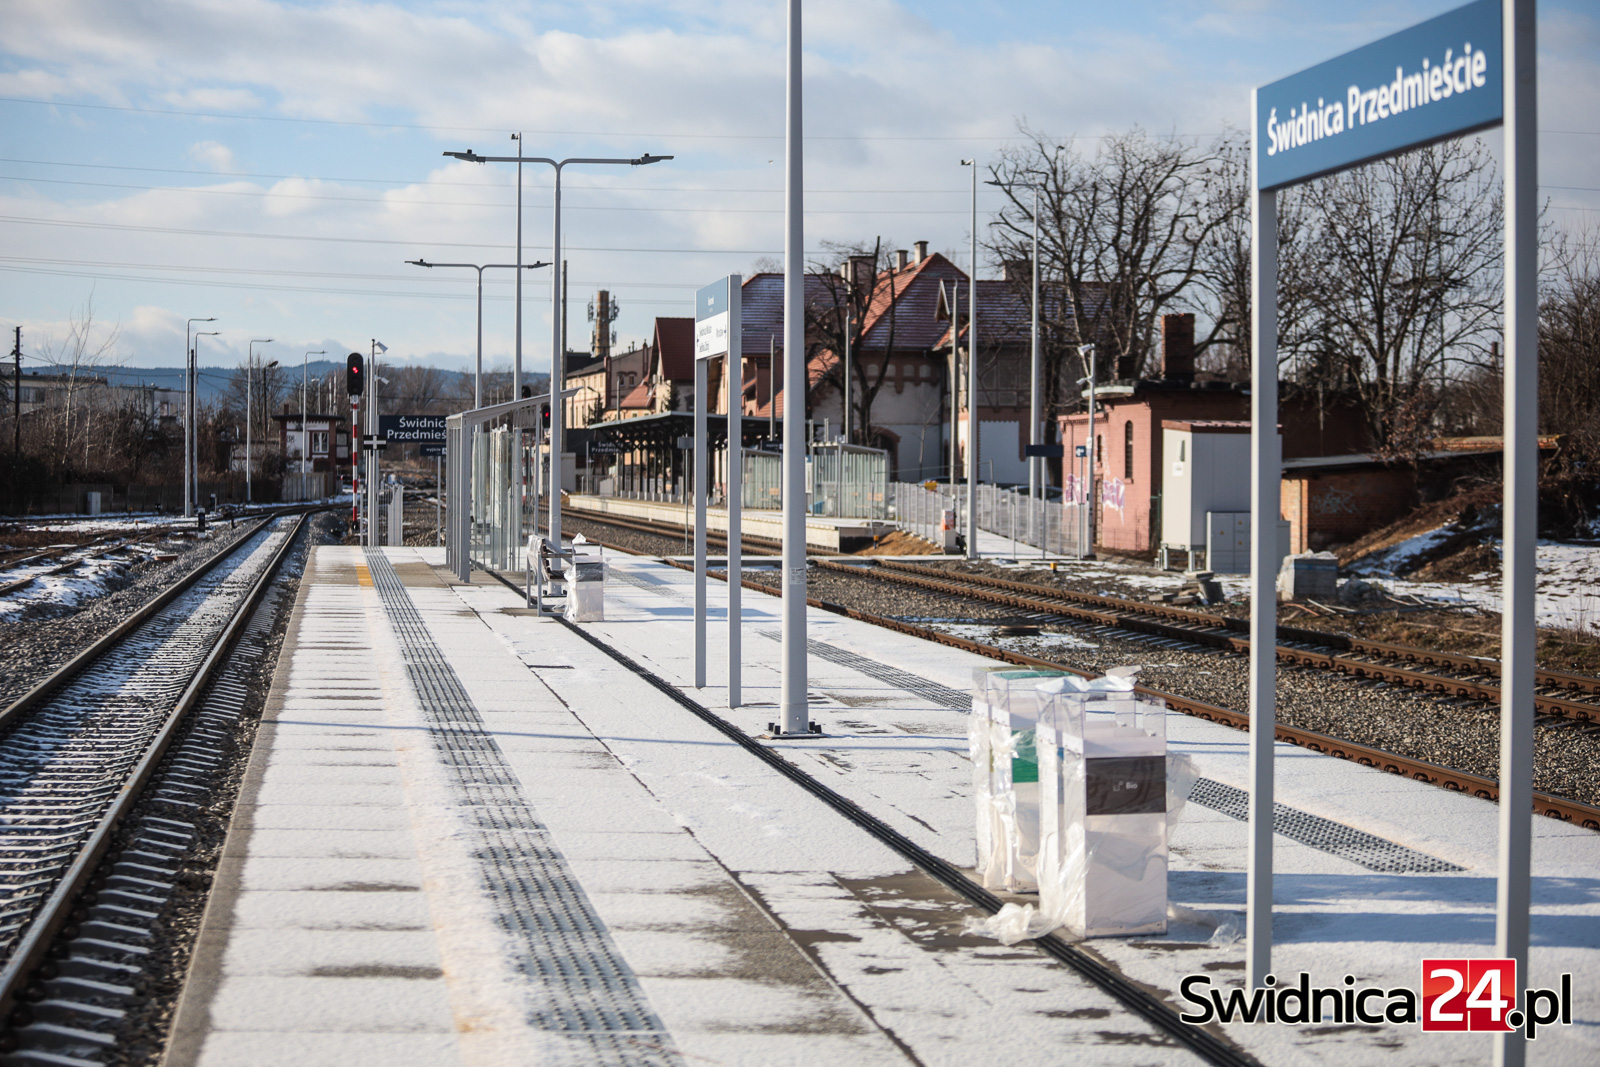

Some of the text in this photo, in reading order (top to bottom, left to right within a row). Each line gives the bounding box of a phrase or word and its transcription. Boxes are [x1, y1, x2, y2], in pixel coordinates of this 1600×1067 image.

[1266, 41, 1487, 157] Świdnica Przedmieście
[1125, 781, 1138, 789] Bio
